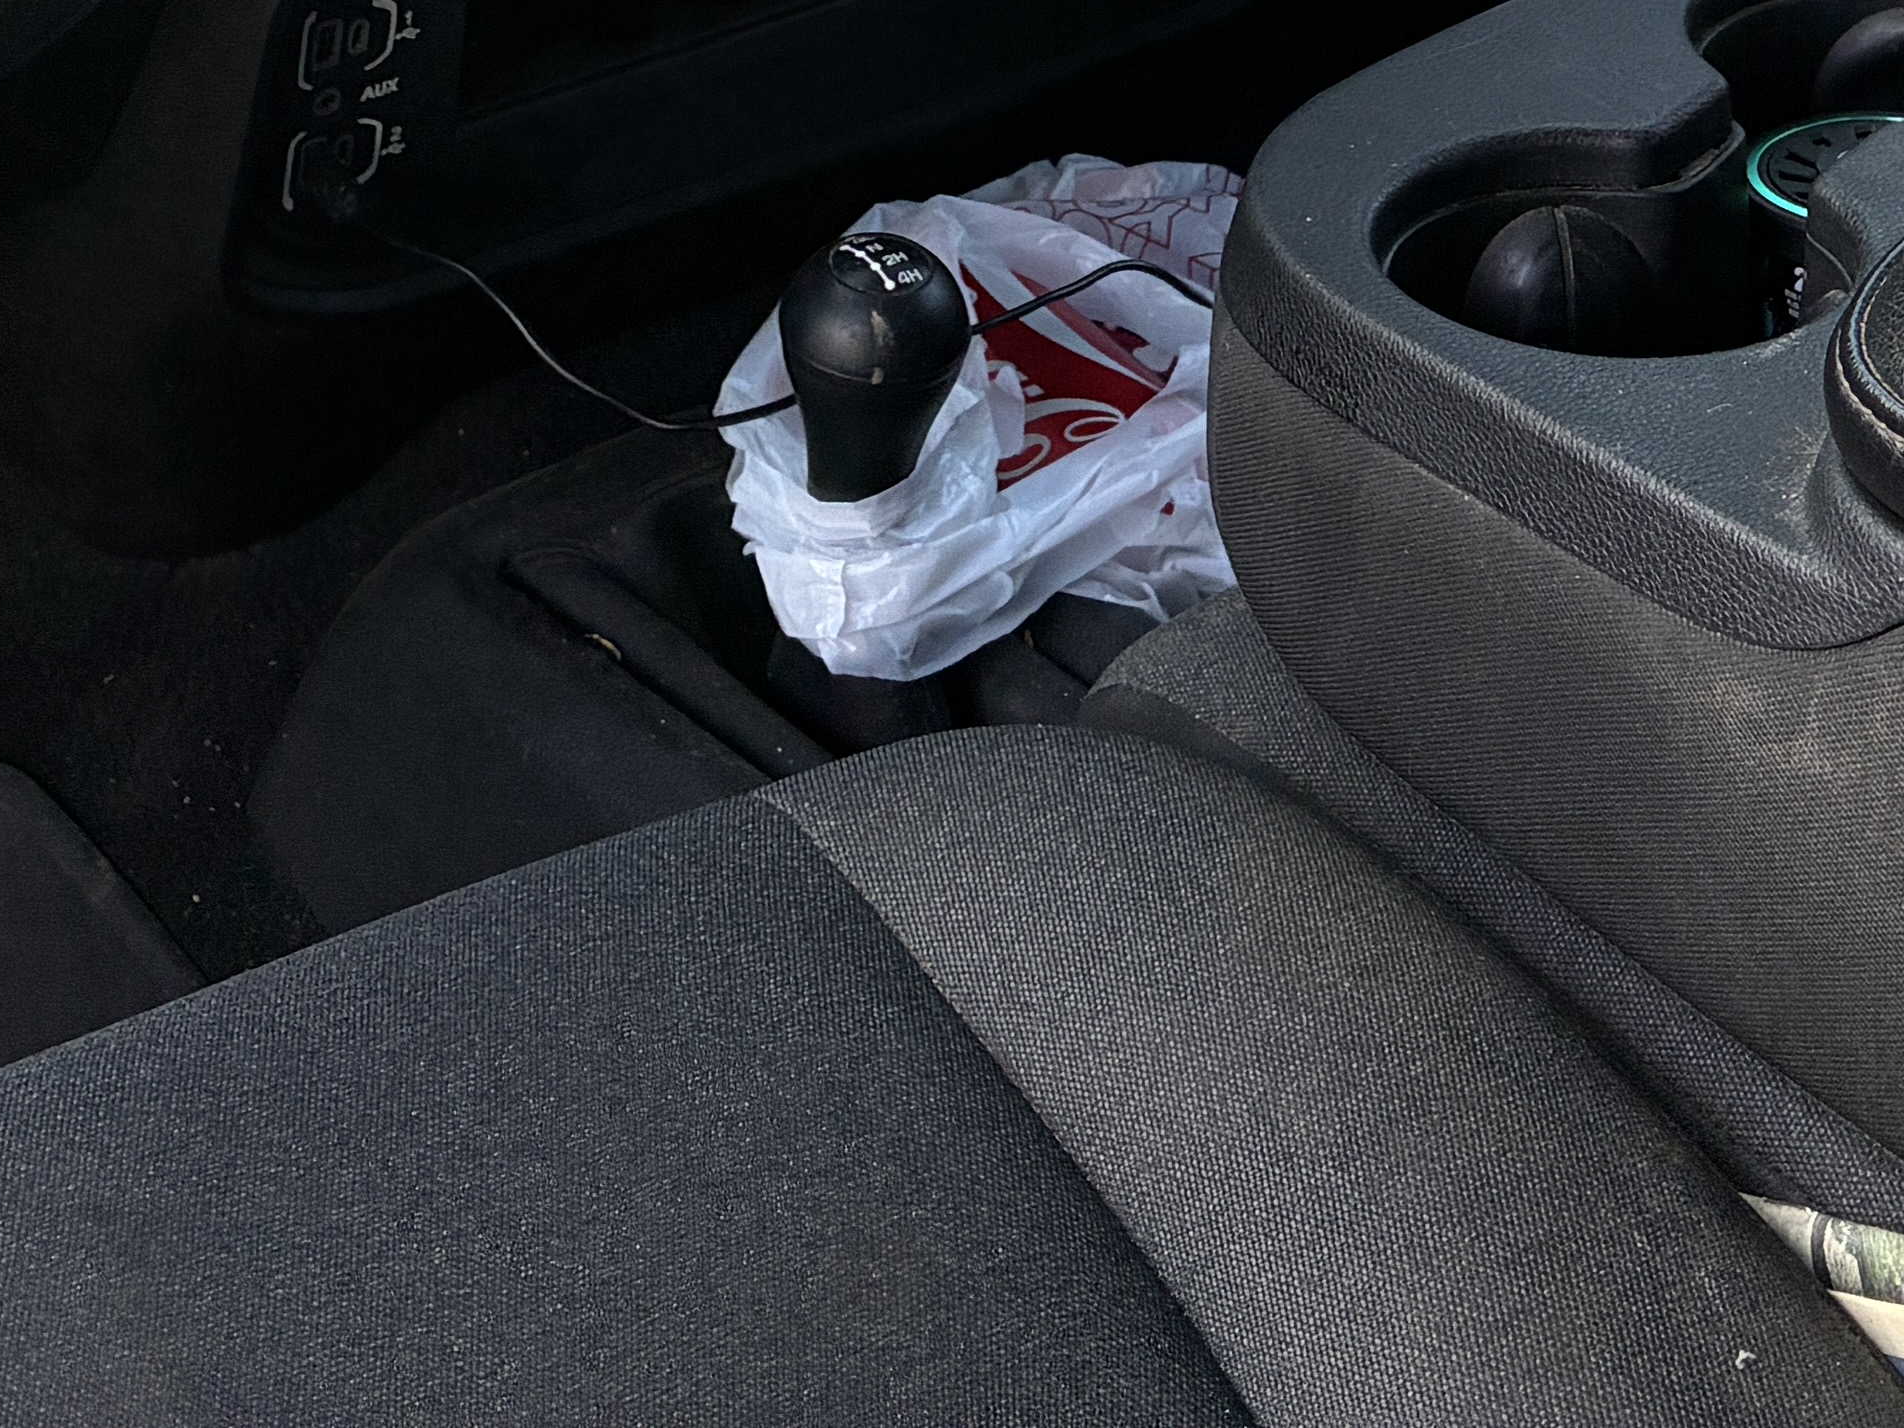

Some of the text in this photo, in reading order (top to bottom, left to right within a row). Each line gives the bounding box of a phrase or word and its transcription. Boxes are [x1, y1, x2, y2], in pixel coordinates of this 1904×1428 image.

[358, 76, 400, 103] AUX
[882, 251, 910, 267] 2H
[897, 268, 924, 284] 4H
